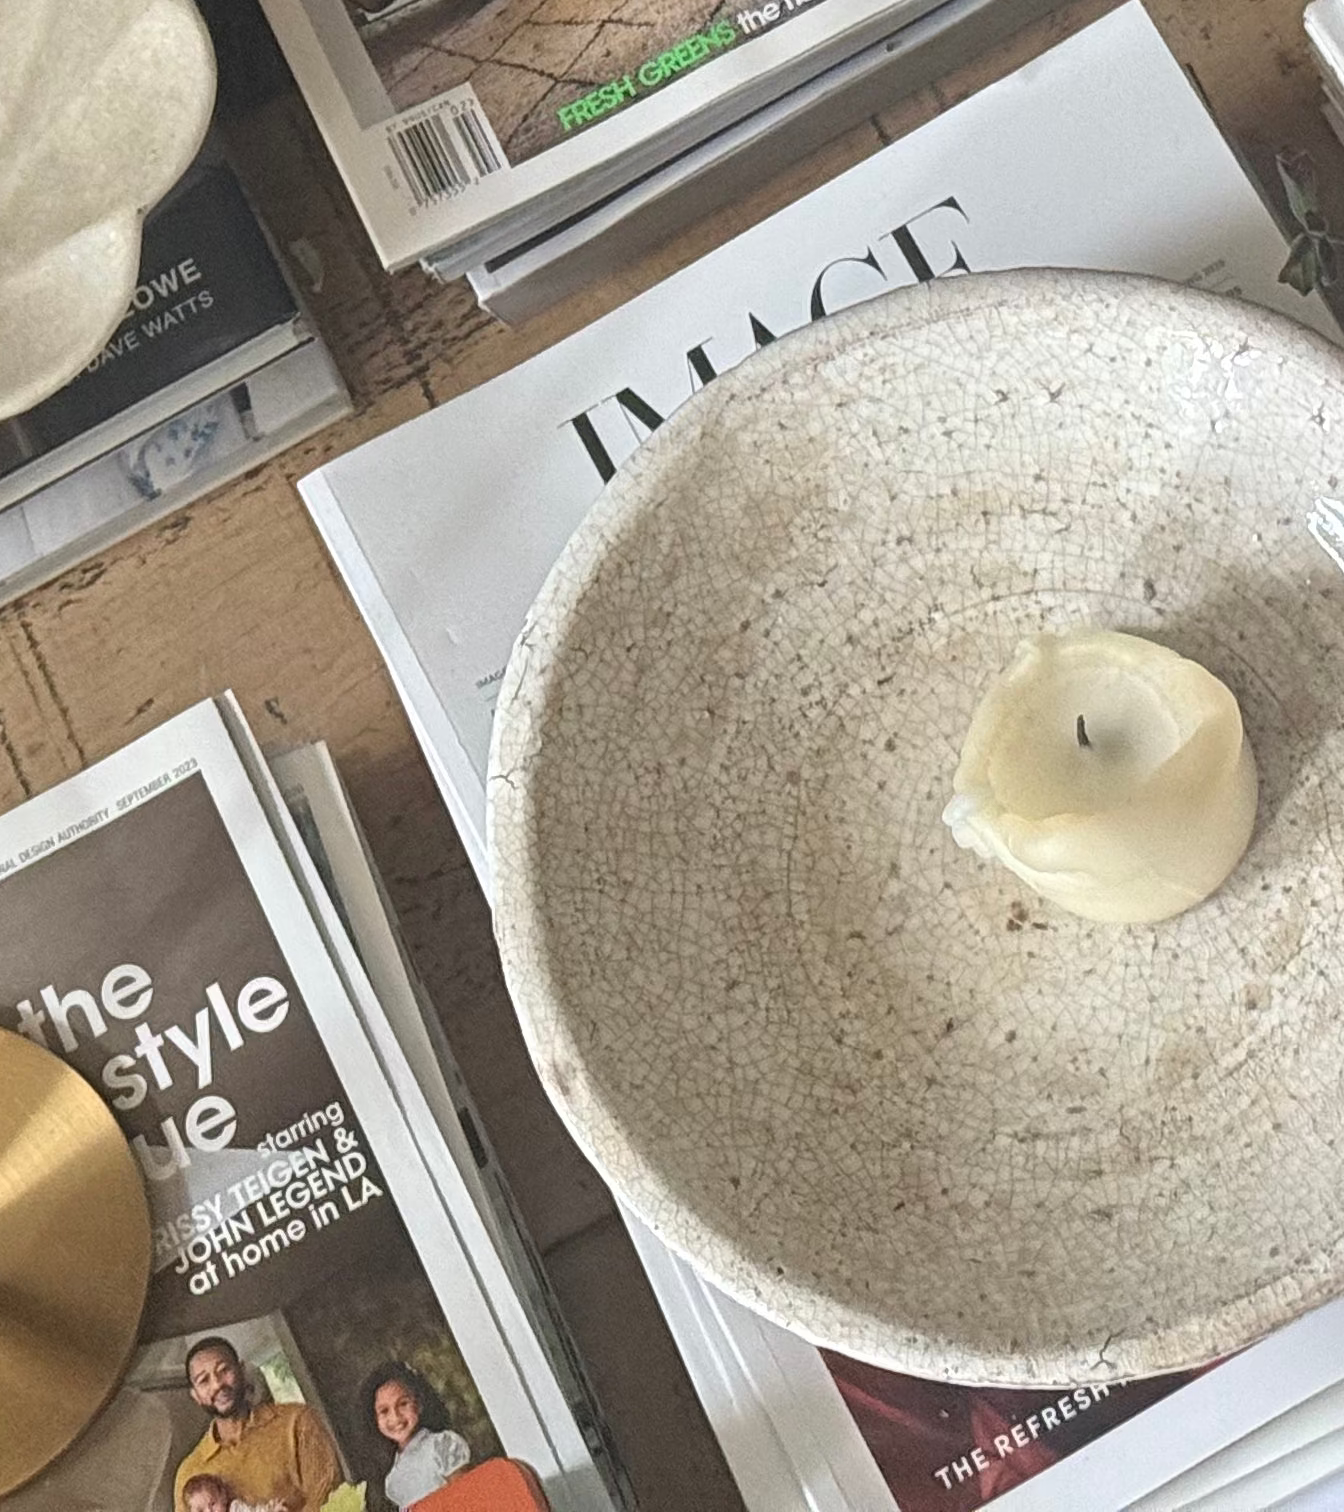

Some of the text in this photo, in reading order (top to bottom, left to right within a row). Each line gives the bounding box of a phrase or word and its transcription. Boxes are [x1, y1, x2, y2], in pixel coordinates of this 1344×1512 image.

[557, 74, 637, 131] FRESH
[638, 20, 736, 86] GREENS
[737, 1, 780, 35] the
[141, 290, 215, 339] WATTS
[18, 836, 55, 864] DESIGN
[57, 808, 110, 844] AUTHORITY
[115, 773, 173, 811] SEPTEMBER
[16, 963, 154, 1053] the
[102, 975, 290, 1111] style
[228, 1138, 331, 1210] TEIGEN
[333, 1126, 359, 1154] &
[256, 1100, 346, 1159] starring
[174, 1151, 367, 1275] JOHN LEGEND
[189, 1175, 384, 1296] at home in LA
[934, 1381, 1111, 1490] THE REFRESH
